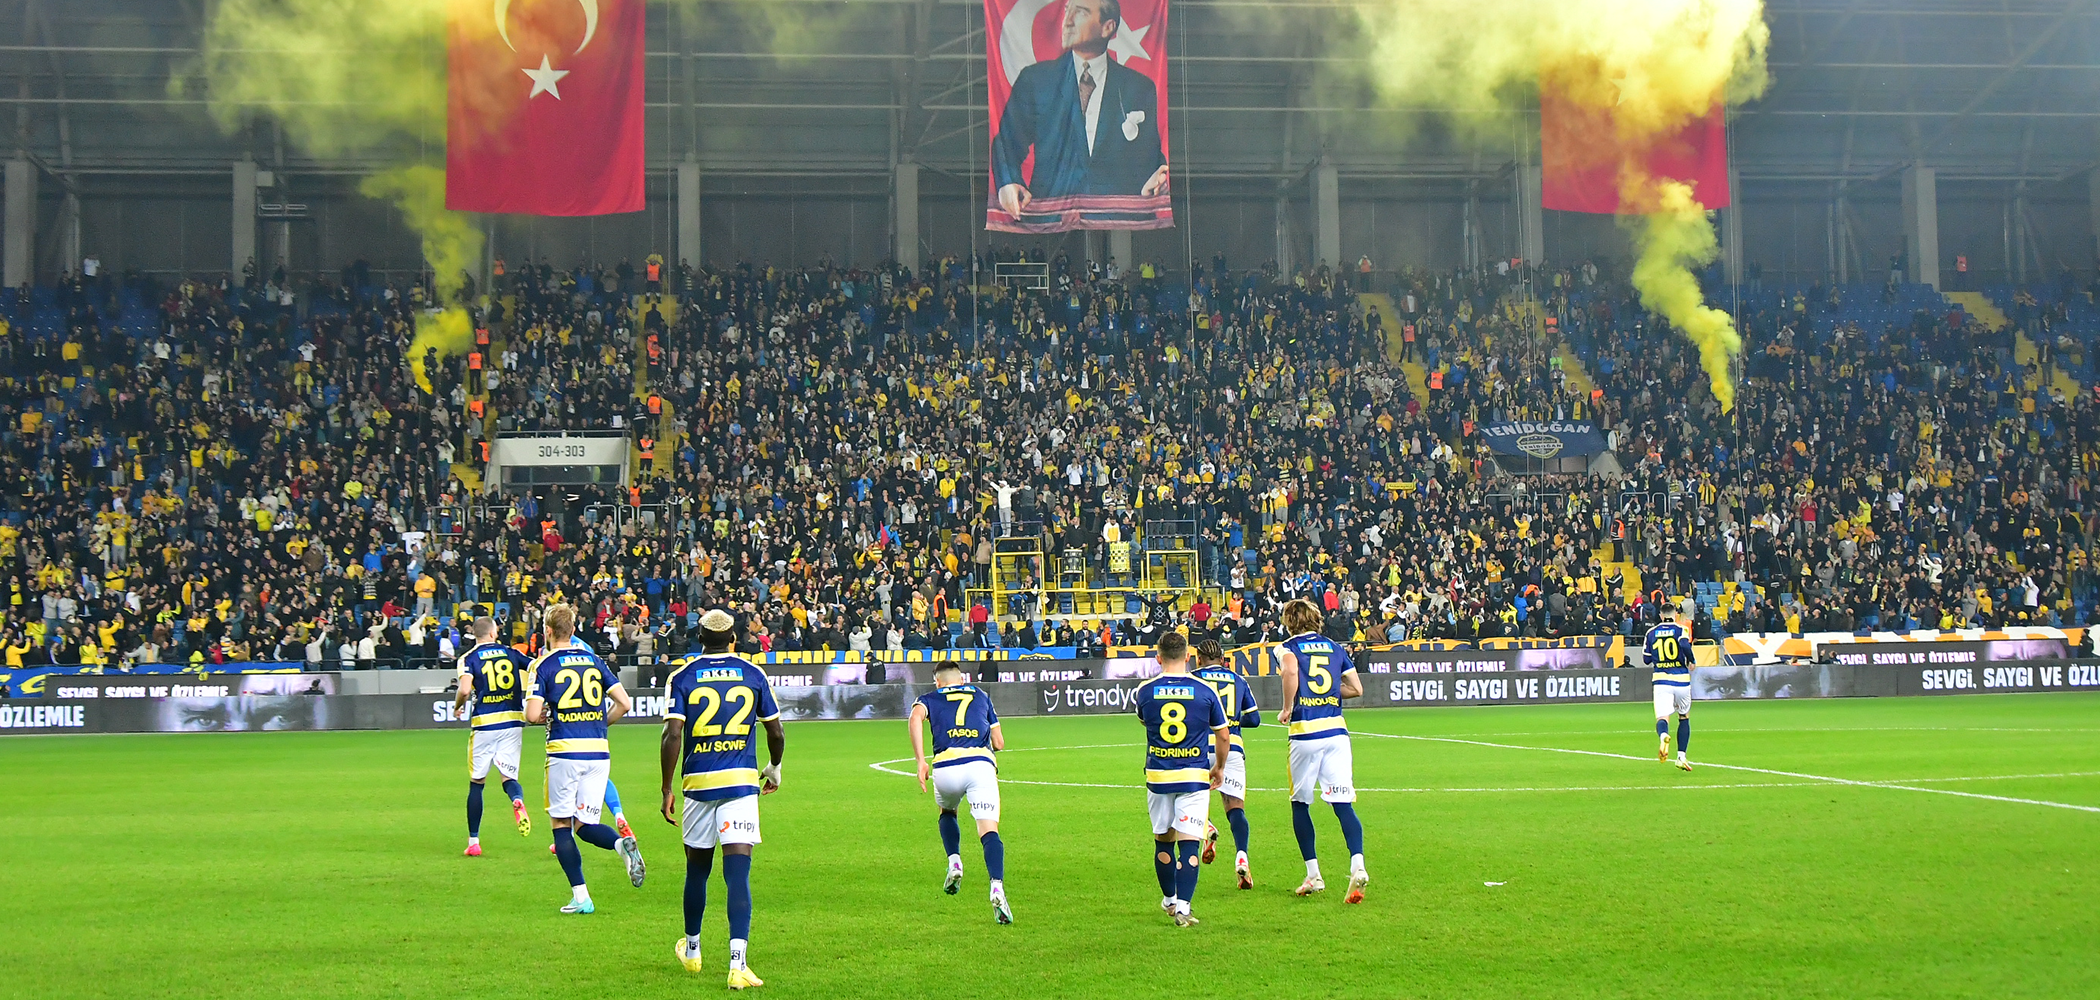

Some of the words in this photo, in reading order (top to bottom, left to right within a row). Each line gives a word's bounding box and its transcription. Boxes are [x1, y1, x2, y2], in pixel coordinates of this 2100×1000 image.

[1481, 420, 1591, 437] YENİDOĞAN
[538, 445, 585, 457] 304-303
[1652, 637, 1678, 661] 10
[481, 659, 515, 691] 18
[1307, 655, 1333, 695] 5
[1983, 668, 2033, 688] SAYGI
[2039, 666, 2062, 687] VE
[555, 667, 603, 709] 26
[1455, 679, 1508, 700] SAYGI
[1515, 678, 1539, 698] VE
[1545, 675, 1620, 698] ÖZLEMLE
[557, 710, 604, 722] RADAKOV
[688, 685, 755, 738] 22
[946, 693, 974, 726] 7
[946, 728, 978, 739] TASOS
[1159, 701, 1188, 744] 8
[1149, 745, 1201, 758] PEDRINHO
[973, 801, 995, 811] tripy
